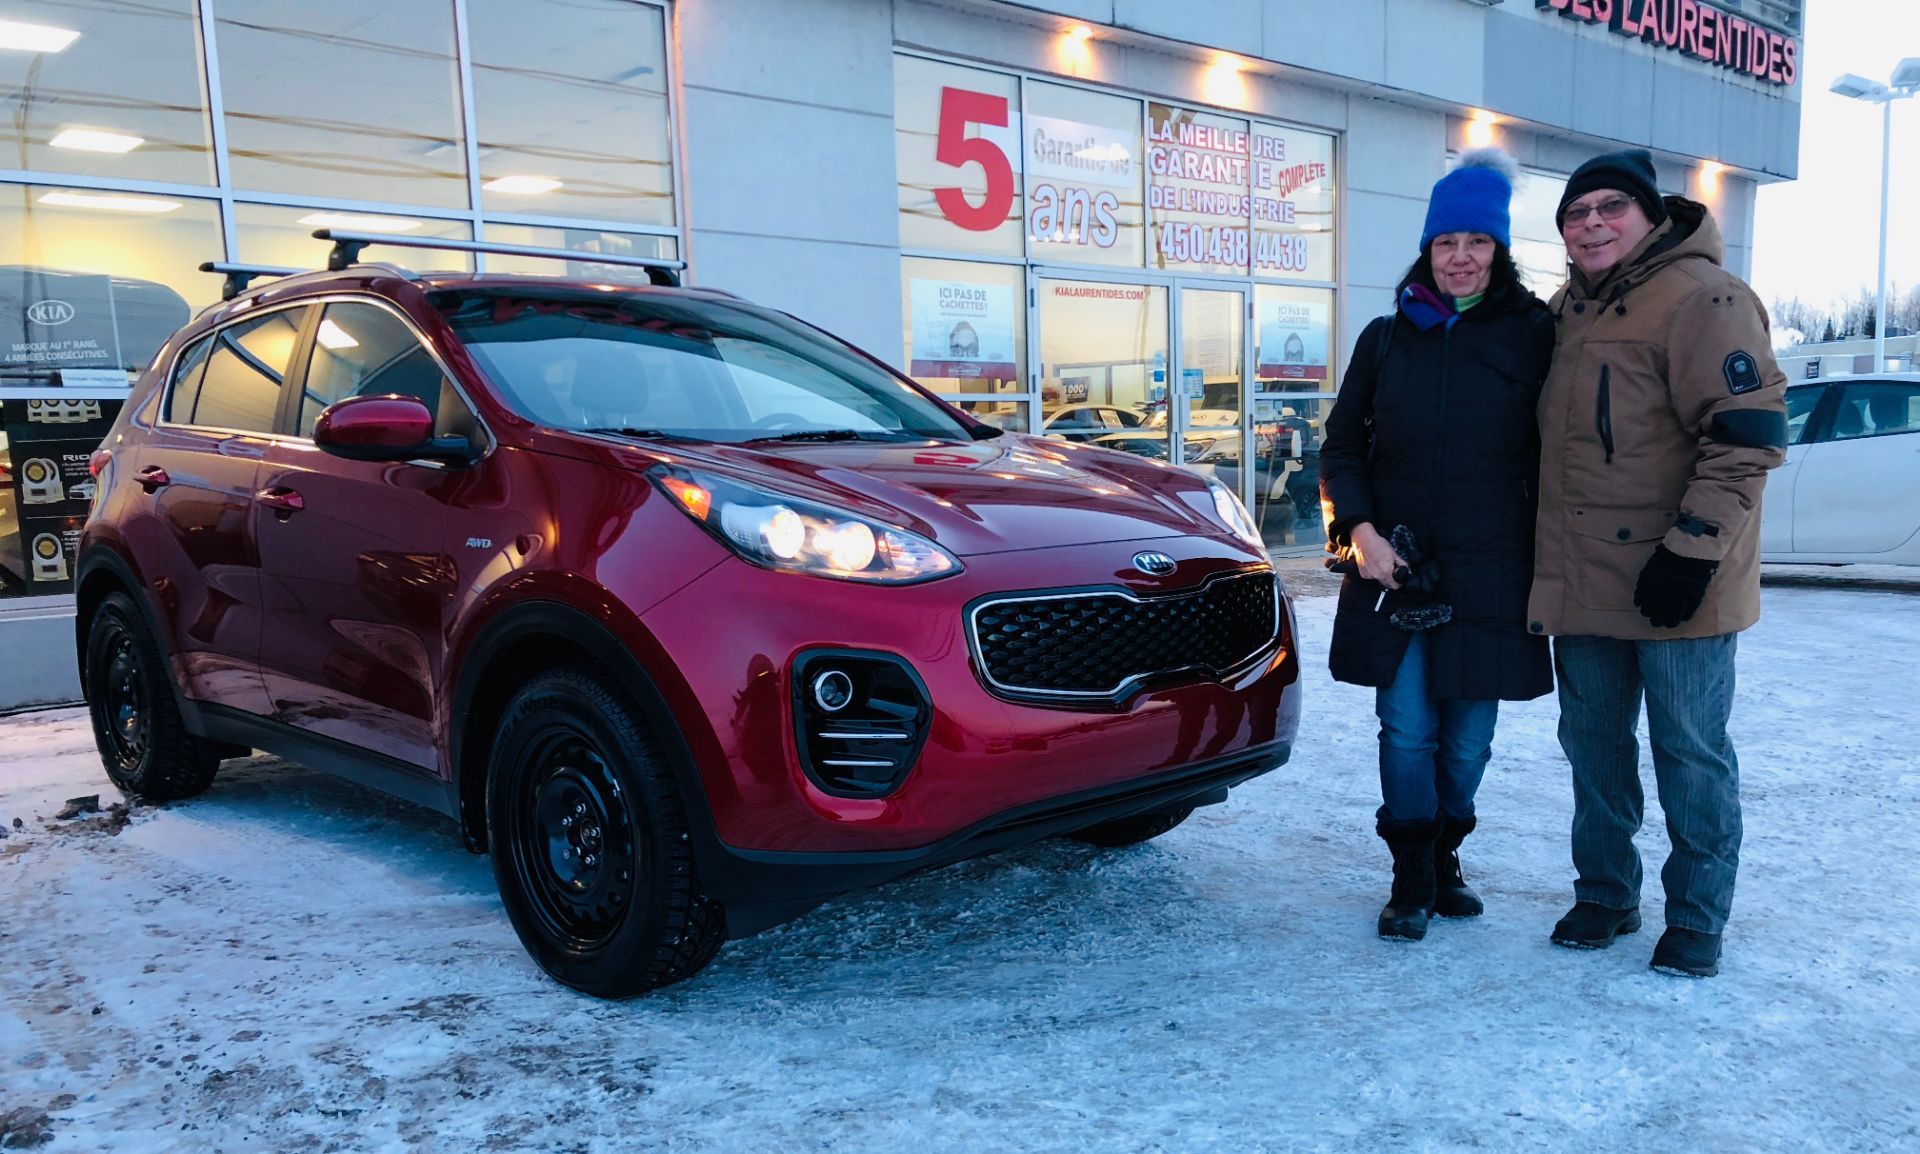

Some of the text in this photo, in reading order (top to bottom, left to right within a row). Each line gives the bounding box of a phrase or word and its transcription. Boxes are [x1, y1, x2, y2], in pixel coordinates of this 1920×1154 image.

[1621, 0, 1797, 86] LAURENTIDES
[1149, 117, 1285, 161] LA MEILLEURE
[934, 86, 1014, 232] 5
[1278, 160, 1326, 199] COMPLÈTE
[1150, 185, 1176, 211] DE
[1031, 184, 1119, 248] ans
[939, 287, 987, 301] ICI PAS DE
[1054, 286, 1145, 300] KIALAURENTIDES.COM
[32, 303, 70, 322] KIA
[12, 342, 49, 352] MARQUE
[50, 342, 62, 350] AU
[464, 537, 492, 549] AWD
